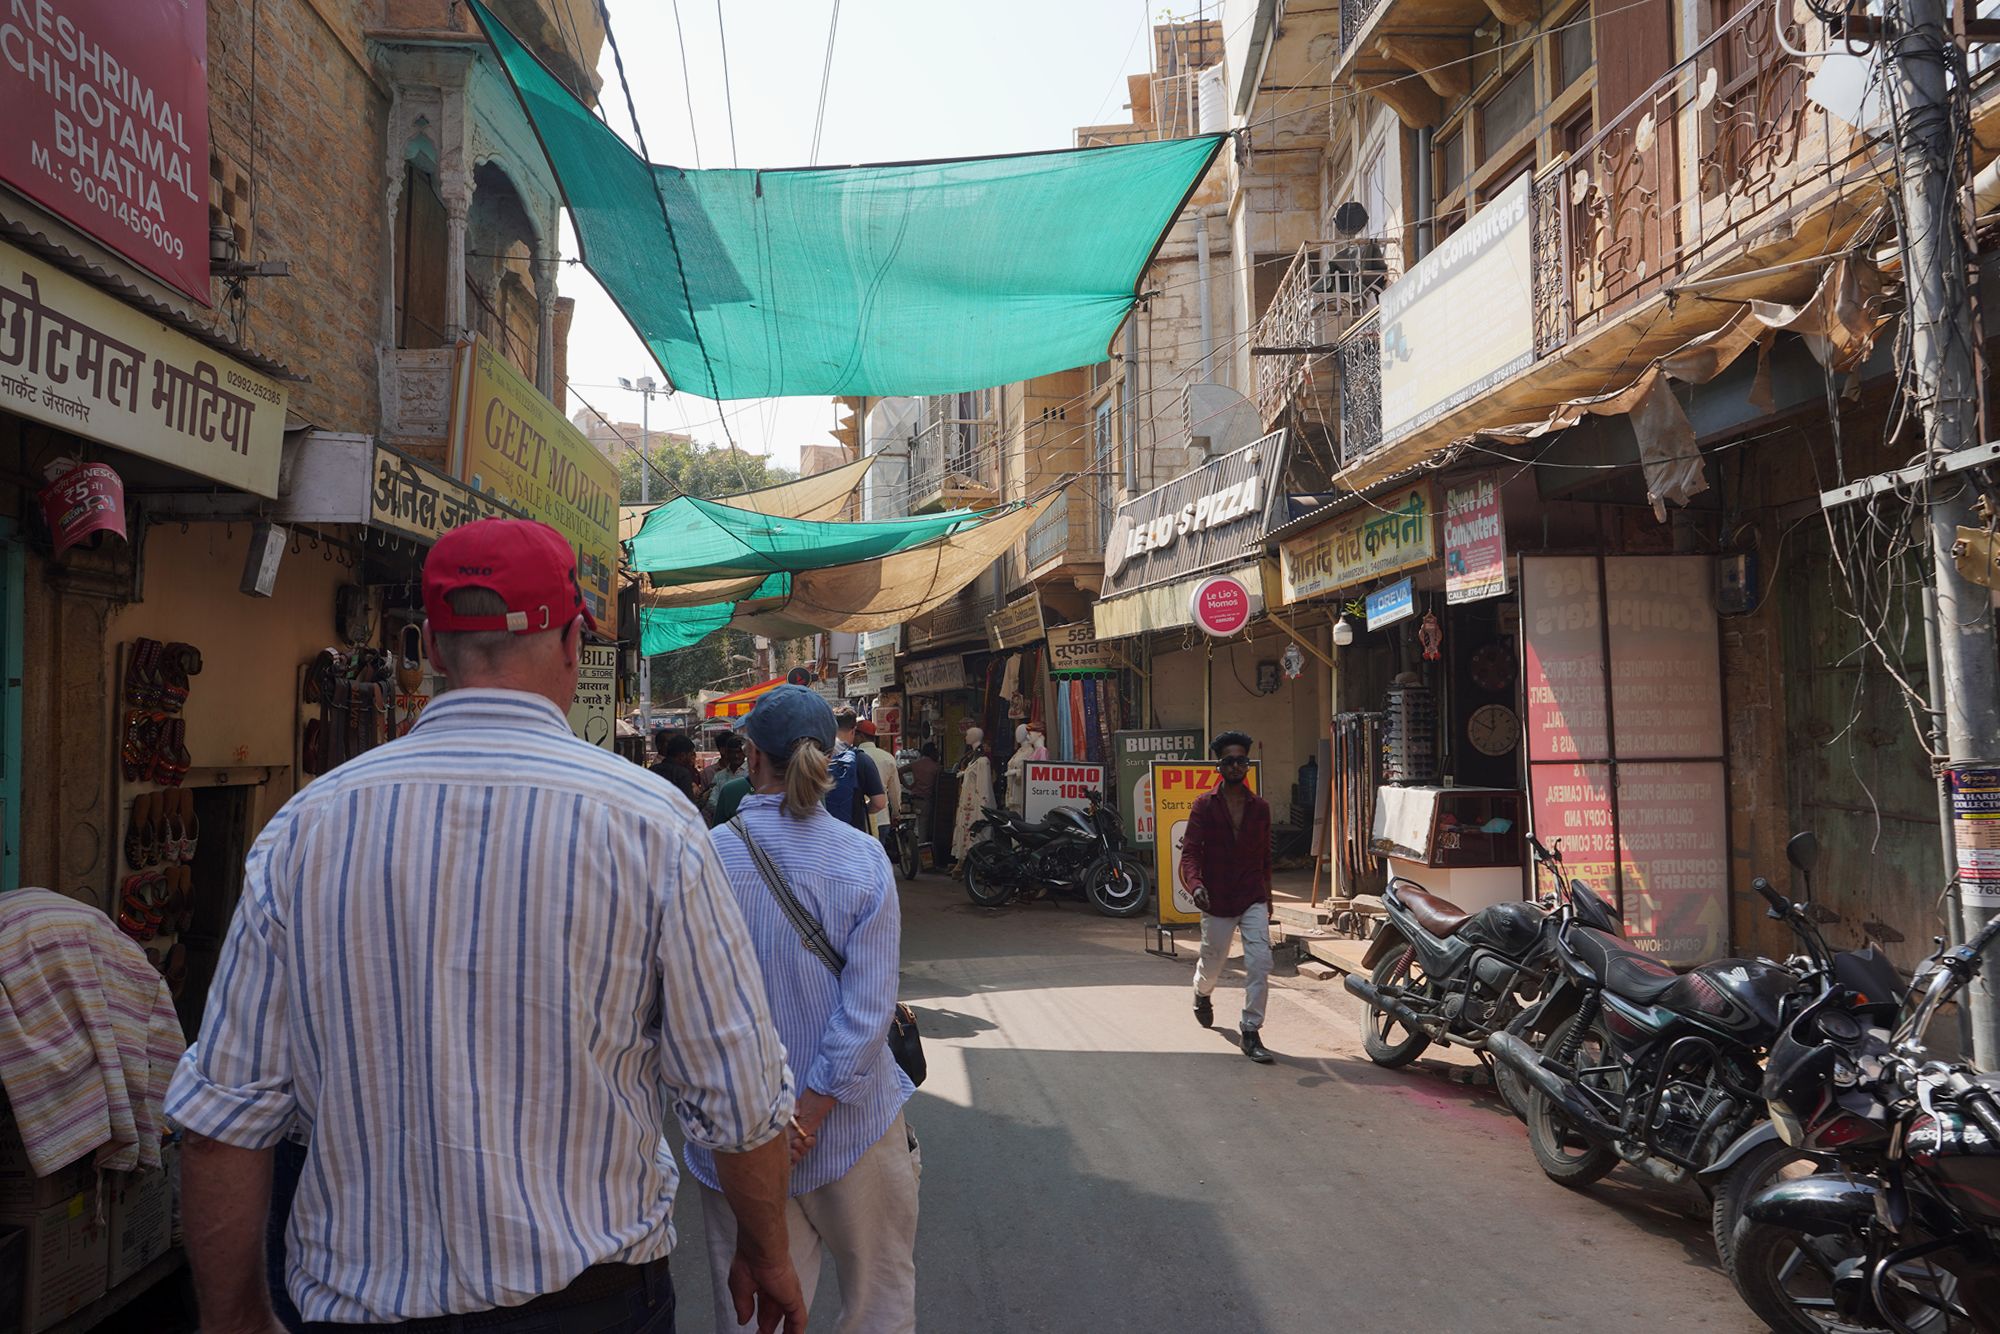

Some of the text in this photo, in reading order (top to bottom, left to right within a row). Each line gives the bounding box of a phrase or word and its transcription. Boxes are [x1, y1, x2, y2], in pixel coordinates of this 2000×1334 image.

[1, 23, 199, 203] CHHOTAMAL
[54, 109, 166, 223] BHATIA
[70, 168, 184, 260] 9001459009
[1381, 279, 1415, 326] Shree
[1417, 257, 1440, 294] Jee
[1441, 193, 1525, 270] Computers
[1472, 379, 1489, 395] CALL
[42, 385, 91, 423] जैसलमेर
[151, 359, 256, 457] भाटिया
[485, 396, 548, 479] GEET
[547, 445, 613, 532] MOBILE
[516, 474, 543, 510] SALE
[544, 493, 552, 515] &
[553, 500, 591, 543] SERVICE
[1125, 523, 1148, 559] LE
[1193, 475, 1264, 532] PIZZA
[1444, 513, 1499, 548] Computers
[1218, 589, 1238, 599] Lio's
[1207, 599, 1238, 609] Momos
[1068, 628, 1095, 642] 555
[581, 650, 615, 667] BILE
[1125, 735, 1196, 753] BURGER
[1126, 758, 1145, 767] Start
[1031, 766, 1099, 783] MOMO
[1162, 769, 1249, 790] PIZ
[1031, 786, 1050, 796] Start
[1966, 793, 2000, 801] HARD
[1161, 798, 1185, 810] Start
